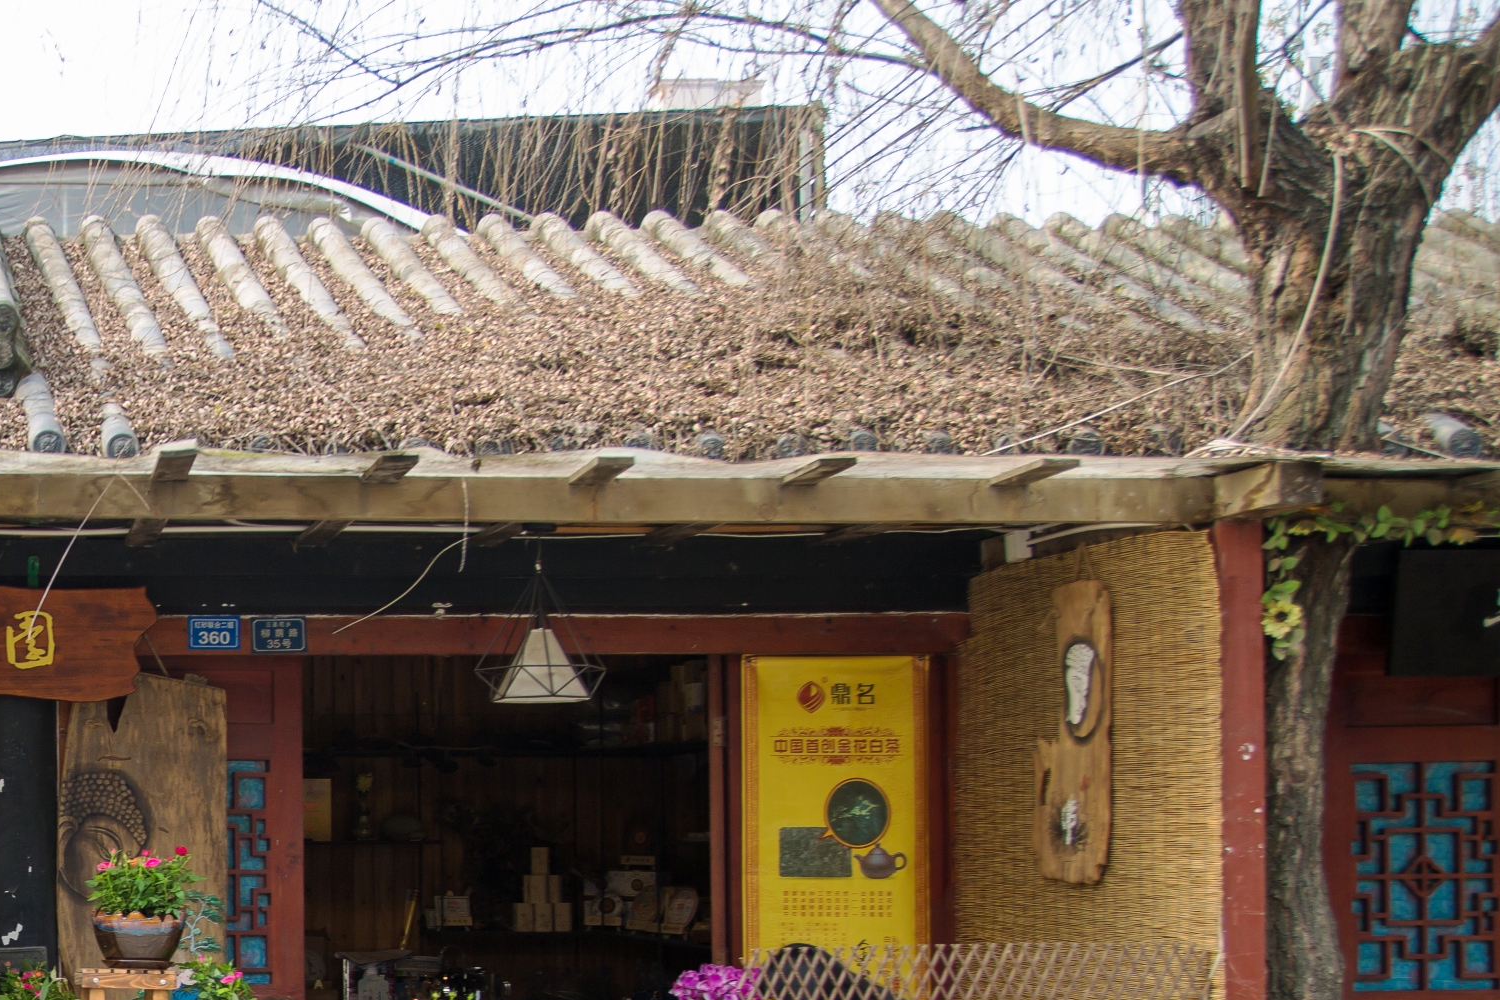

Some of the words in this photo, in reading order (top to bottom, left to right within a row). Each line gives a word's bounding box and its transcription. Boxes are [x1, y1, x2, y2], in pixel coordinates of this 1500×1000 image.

[198, 631, 230, 645] 360
[266, 639, 292, 649] 35号
[830, 683, 876, 705] 鼎名
[773, 738, 900, 754] 中国首创金花白茶
